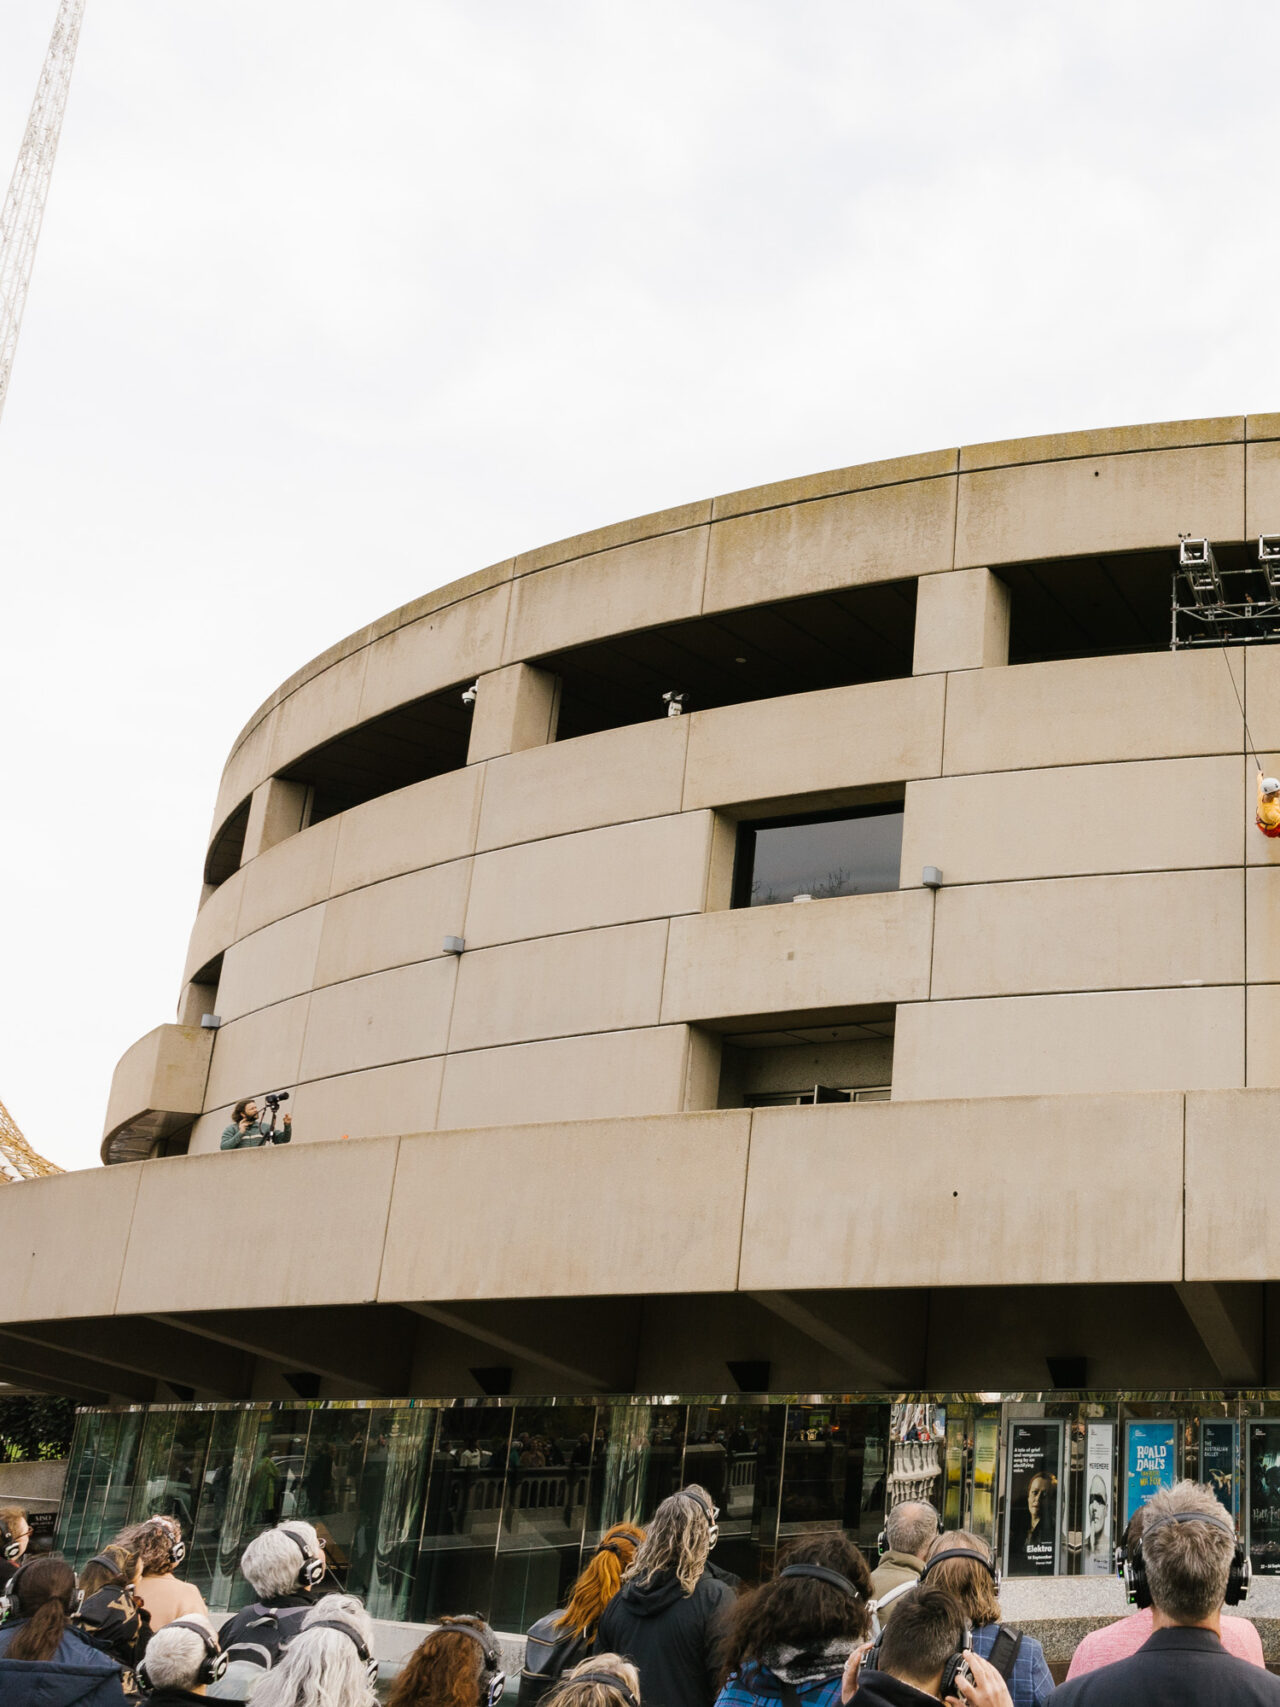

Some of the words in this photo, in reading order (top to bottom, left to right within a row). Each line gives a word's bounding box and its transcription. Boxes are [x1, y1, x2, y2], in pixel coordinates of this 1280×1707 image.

[1136, 1445, 1167, 1459] ROALD
[1135, 1457, 1166, 1472] DAHL'S
[1027, 1544, 1053, 1553] Elektra
